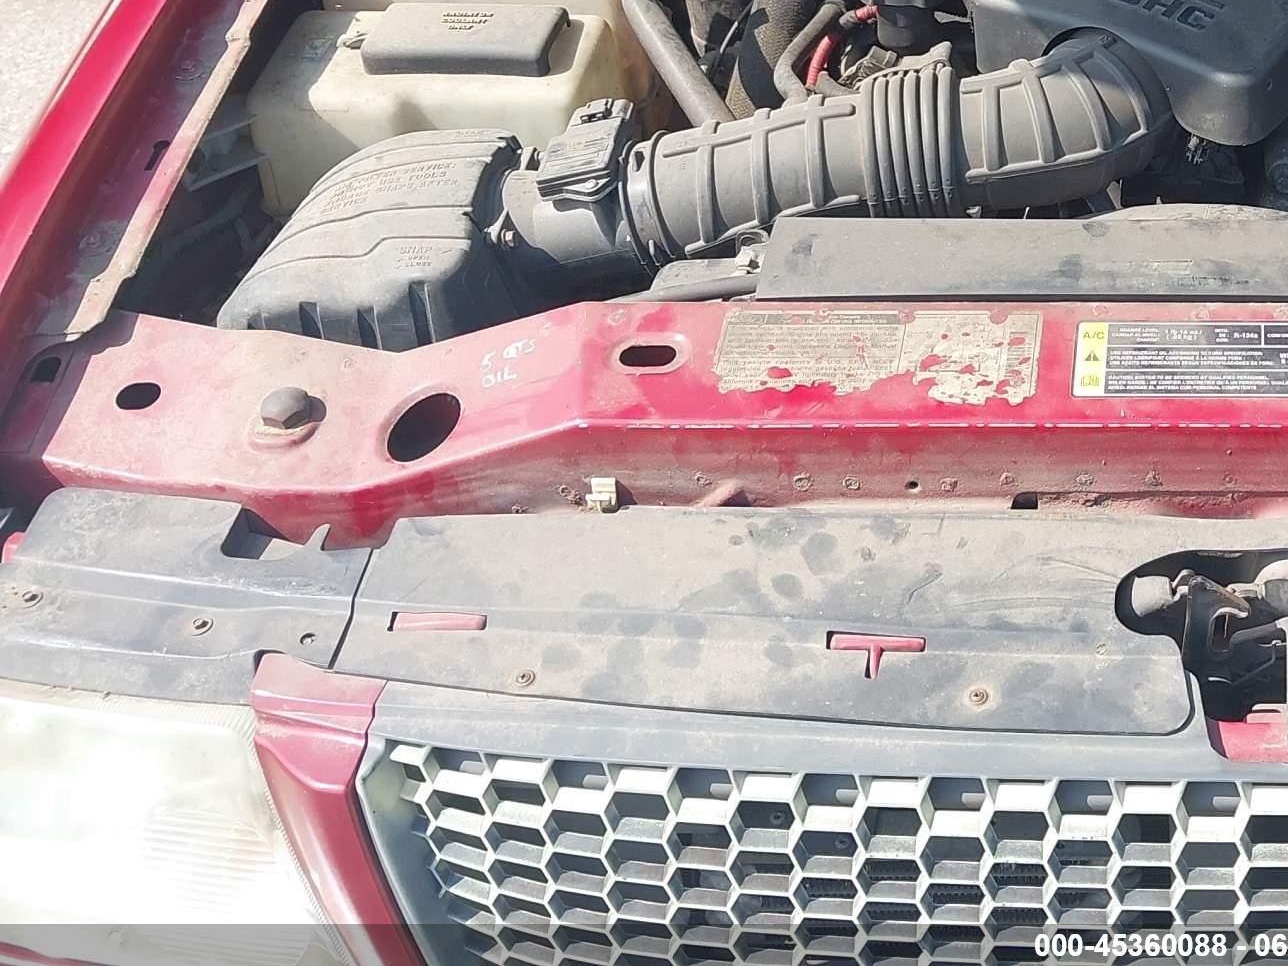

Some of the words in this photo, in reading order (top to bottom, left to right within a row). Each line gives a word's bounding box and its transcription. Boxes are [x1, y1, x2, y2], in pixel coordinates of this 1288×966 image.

[399, 245, 433, 255] SNAP
[1082, 331, 1105, 340] A/C
[482, 366, 518, 388] OIL
